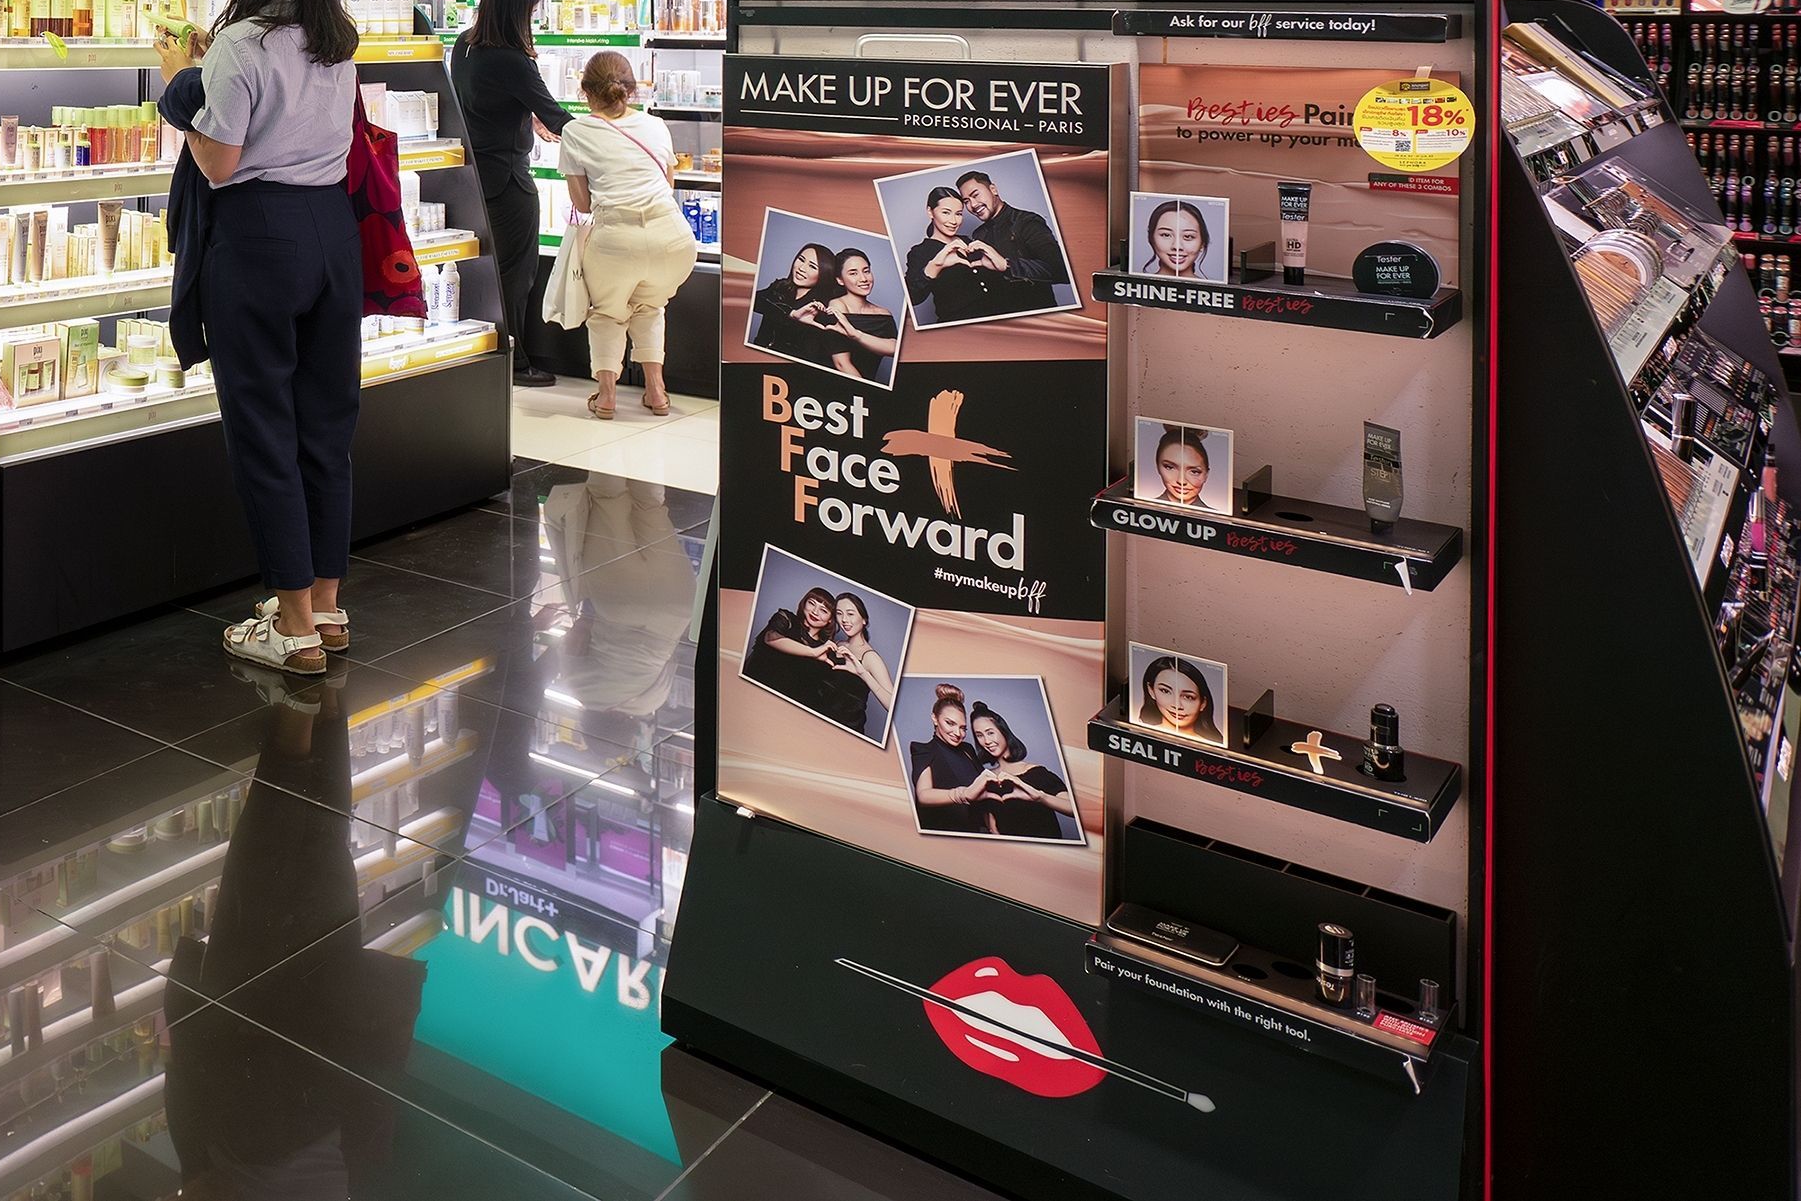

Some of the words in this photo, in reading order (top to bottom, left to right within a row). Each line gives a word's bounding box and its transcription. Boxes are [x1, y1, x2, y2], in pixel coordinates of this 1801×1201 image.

[1169, 15, 1196, 29] Ask
[1198, 14, 1219, 29] for
[1221, 18, 1246, 30] our
[1248, 13, 1272, 38] bff
[1275, 17, 1325, 31] service
[1328, 18, 1376, 35] today!
[740, 71, 837, 105] MAKE
[849, 75, 893, 107] UP
[903, 76, 976, 111] FOR
[989, 80, 1083, 116] EVER
[904, 113, 1020, 132] PROFESSIONAL
[1038, 119, 1083, 135] PARIS
[1187, 95, 1300, 129] Besties
[1406, 104, 1465, 127] 18%
[1176, 126, 1192, 139] to
[1198, 128, 1254, 144] power
[1260, 134, 1283, 148] up
[1288, 134, 1330, 149] your
[1398, 182, 1417, 190] THESE
[1423, 184, 1452, 192] COMBOS
[1287, 241, 1302, 249] HD
[1375, 265, 1398, 273] MAKE
[1399, 265, 1410, 273] UP
[1376, 255, 1402, 263] Tester
[1376, 272, 1392, 280] FOR
[1392, 272, 1411, 280] EVER
[1113, 281, 1235, 310] SHINE-FREE
[1242, 295, 1314, 315] Besties
[762, 374, 870, 439] Best
[1366, 438, 1379, 447] FOR
[1367, 432, 1385, 443] MAKE
[1384, 437, 1393, 445] UP
[779, 425, 901, 494] Face
[793, 474, 1026, 572] Forward
[1111, 508, 1180, 535] GLOW
[1186, 521, 1218, 542] UP
[1226, 531, 1298, 556] Besties
[933, 567, 1048, 615] #mymakeupbff
[1108, 733, 1157, 761] SEAL
[1163, 748, 1182, 767] IT
[1194, 758, 1265, 787] Besties
[1094, 955, 1116, 974] Pair
[1117, 966, 1143, 983] your
[1144, 973, 1204, 1004] foundation
[1206, 997, 1232, 1015] with
[1233, 1005, 1253, 1021] the
[1254, 1013, 1283, 1033] right
[1284, 1024, 1312, 1042] tool.
